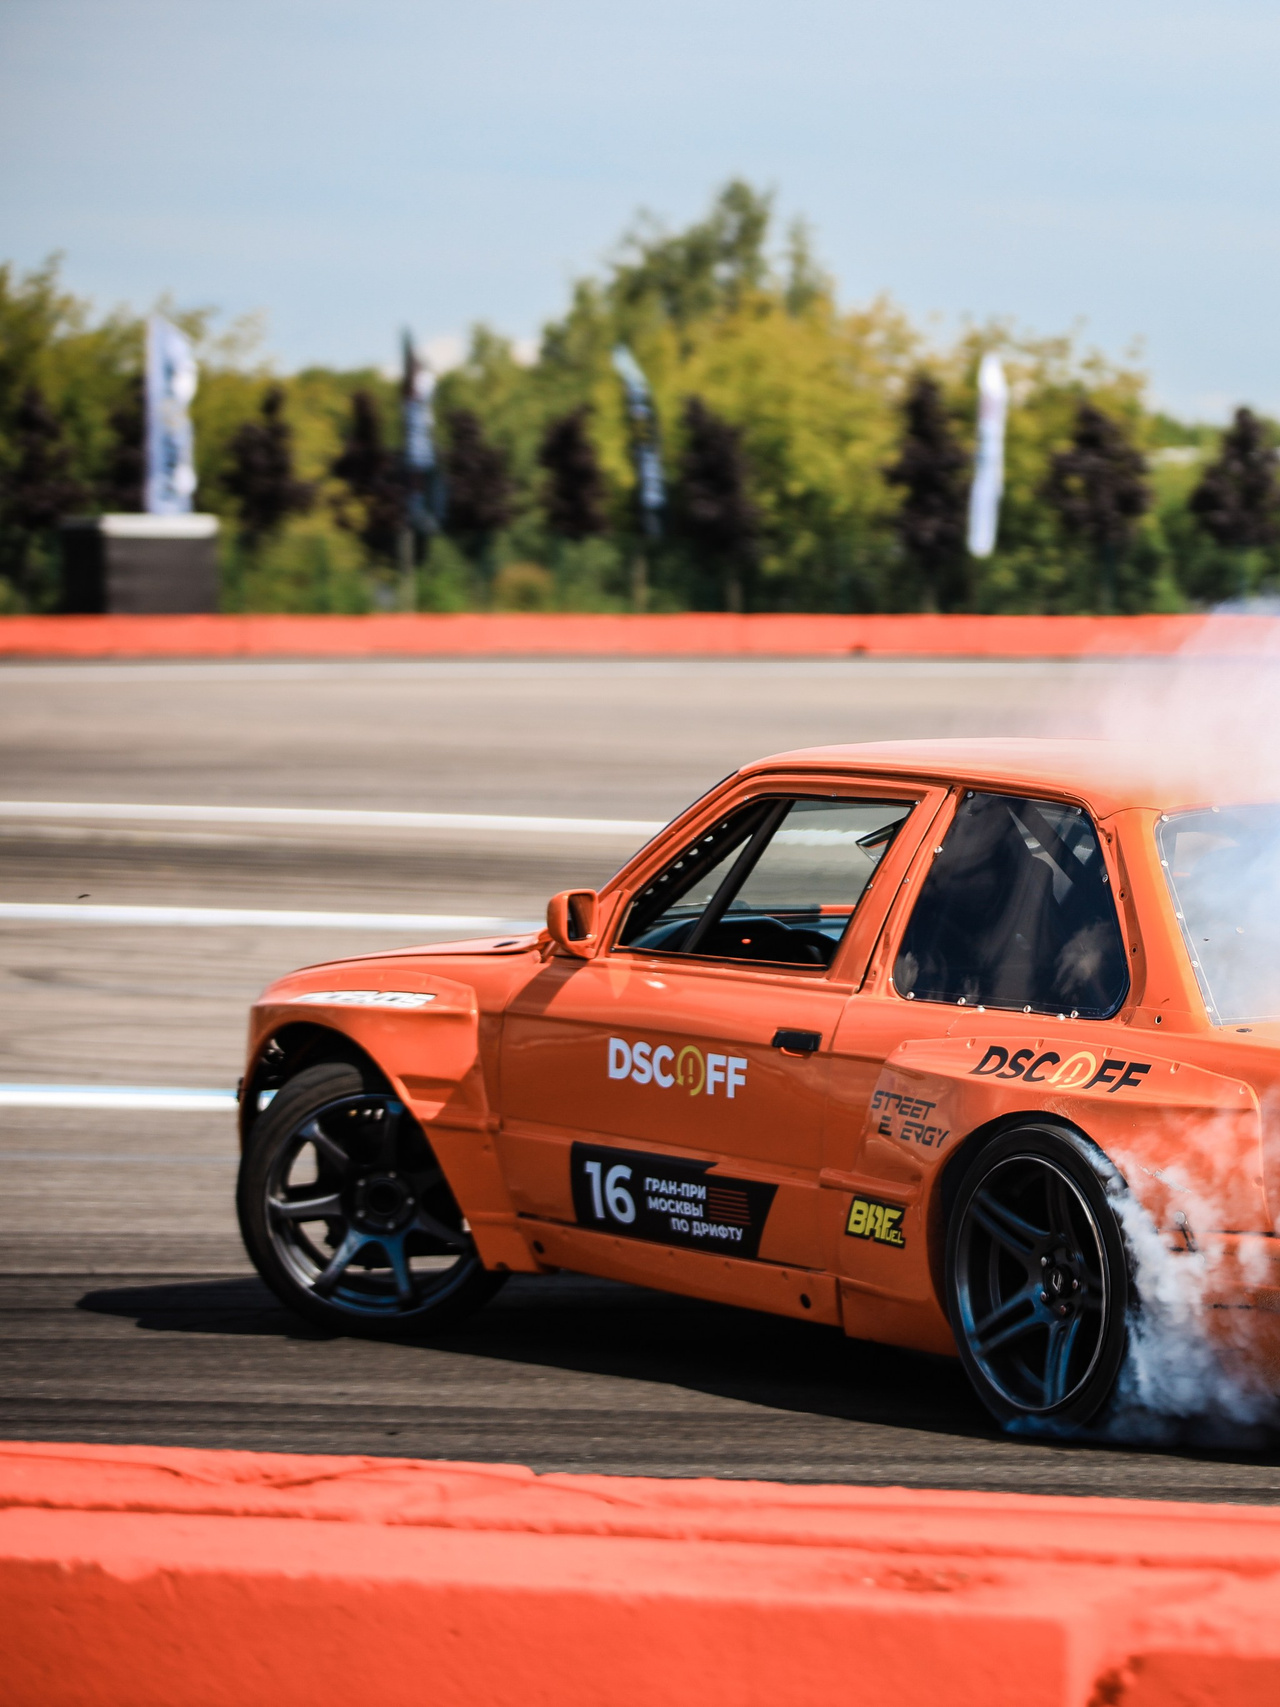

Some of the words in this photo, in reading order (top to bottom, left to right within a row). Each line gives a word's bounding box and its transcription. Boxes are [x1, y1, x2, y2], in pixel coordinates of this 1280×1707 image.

[871, 1090, 938, 1121] STREET
[877, 1115, 951, 1148] EERGY
[584, 1160, 637, 1225] 16
[644, 1177, 707, 1200] ГРАН-ПРИ
[648, 1196, 704, 1217] МОСКВЫ
[670, 1217, 690, 1232] ПО
[692, 1221, 744, 1242] ДРИФТУ
